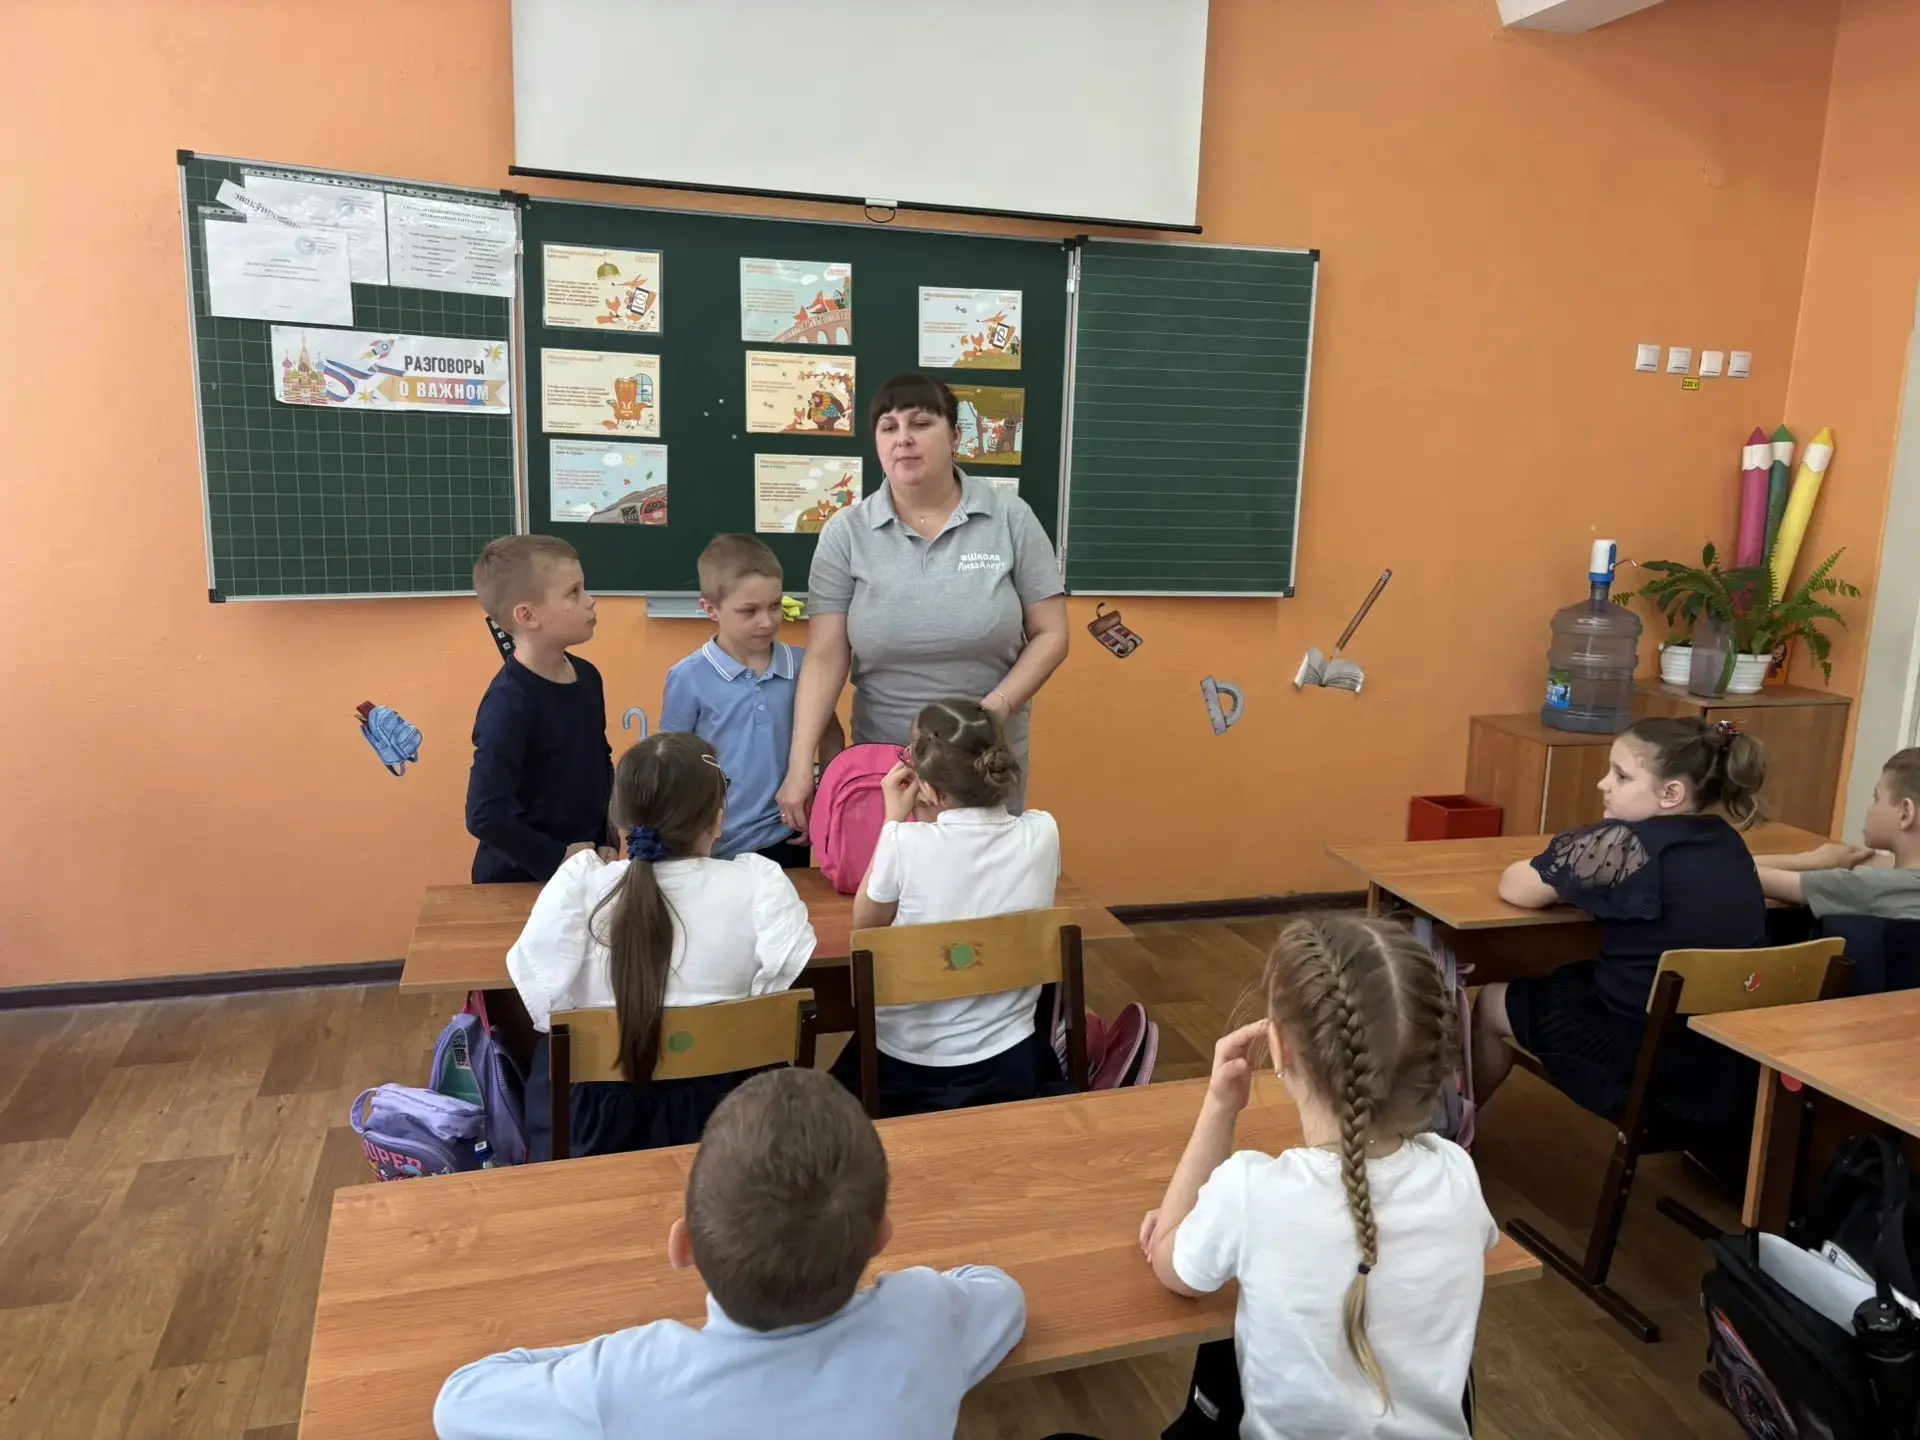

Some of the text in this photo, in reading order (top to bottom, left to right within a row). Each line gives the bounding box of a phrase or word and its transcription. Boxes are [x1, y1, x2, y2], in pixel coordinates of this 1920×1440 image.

[404, 355, 485, 375] РАЗГОВОРЫ
[399, 380, 489, 401] О ВАЖНОМ
[1683, 380, 1693, 388] 220
[957, 561, 1005, 572] ЛизаАлерт
